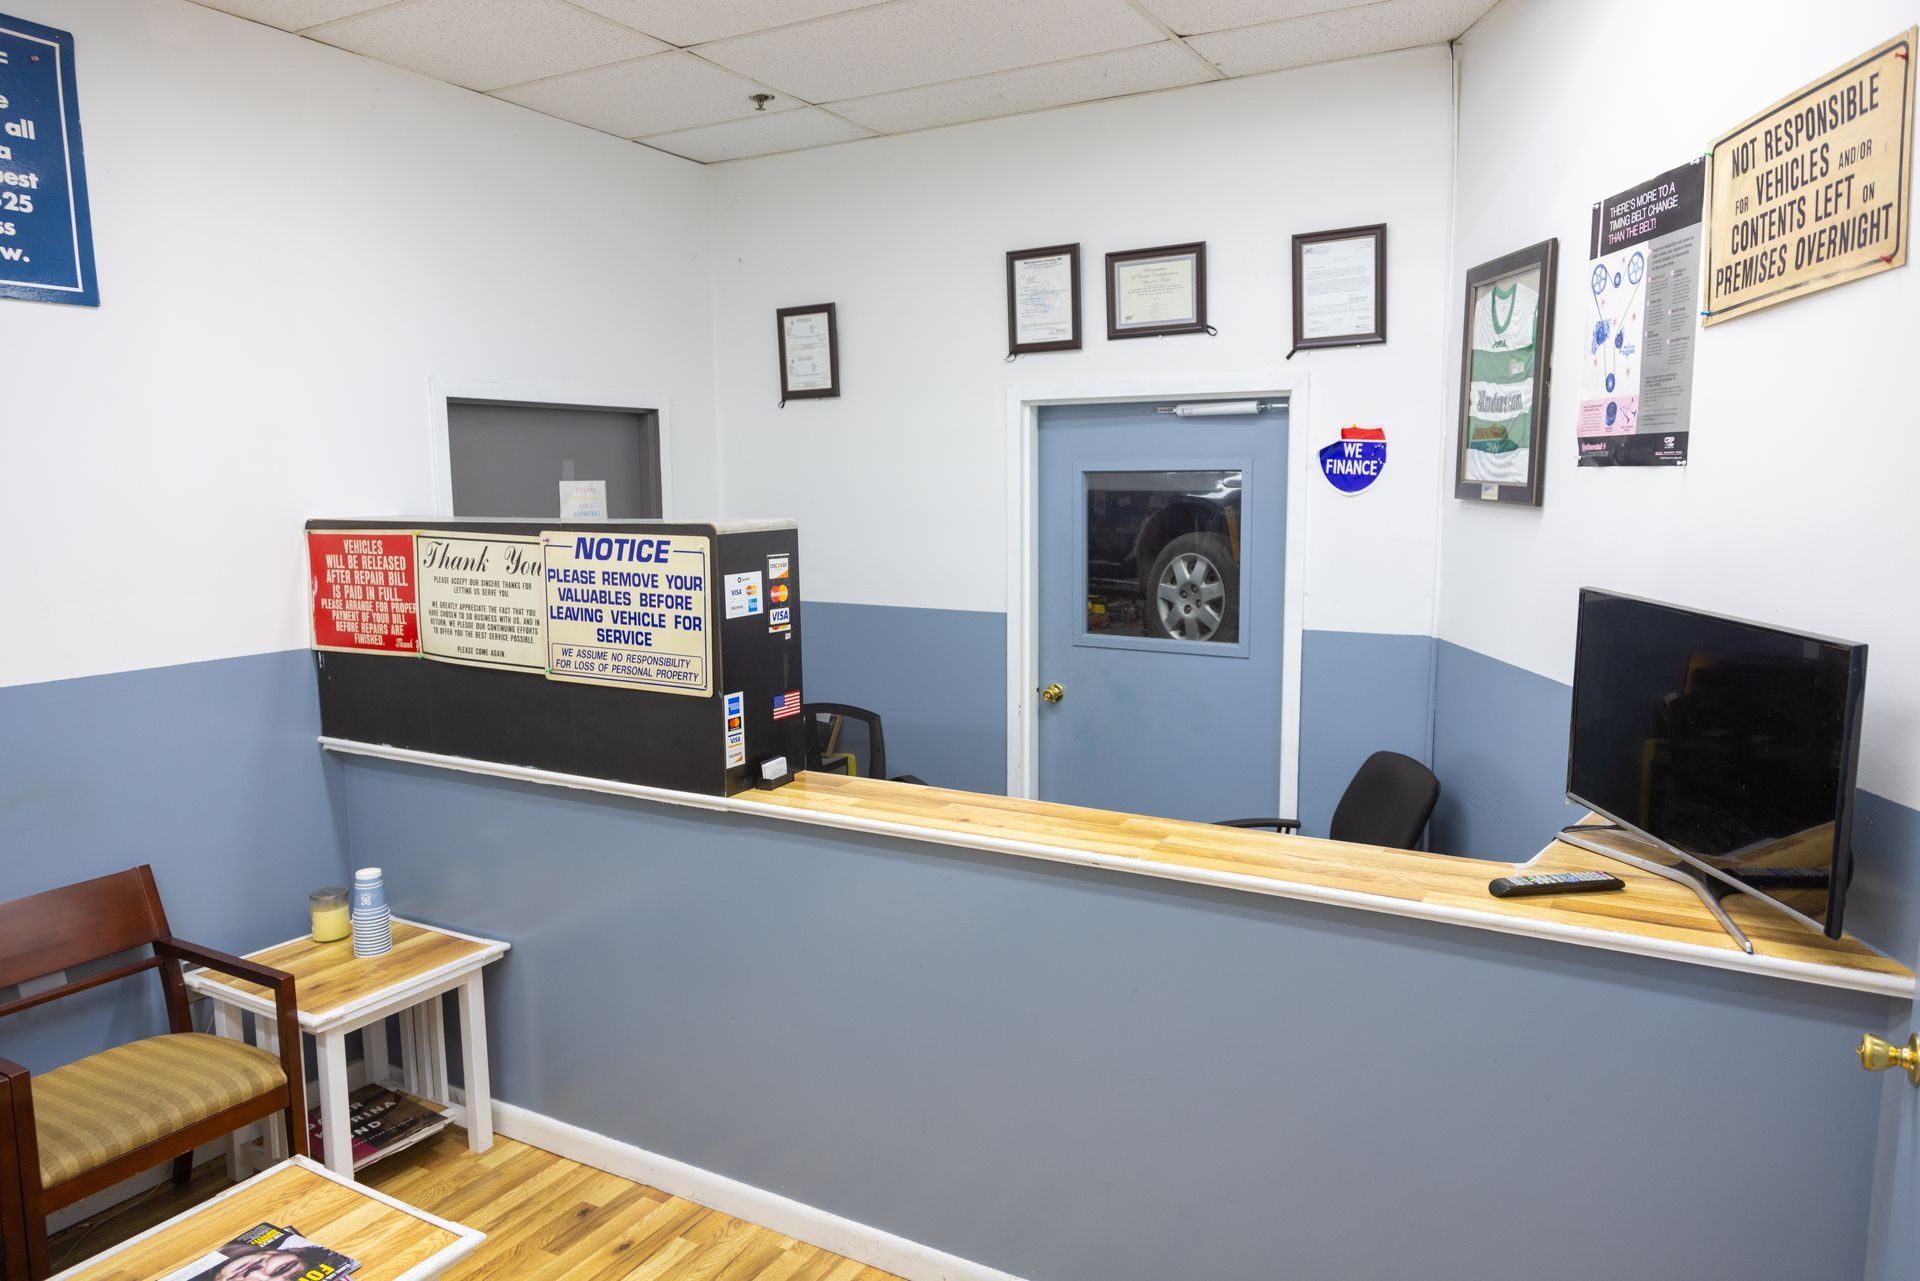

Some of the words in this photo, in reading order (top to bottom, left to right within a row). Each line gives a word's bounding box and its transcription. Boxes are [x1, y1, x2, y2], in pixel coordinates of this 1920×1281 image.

[5, 118, 35, 140] all
[1732, 136, 1757, 179] NOT
[1765, 72, 1879, 163] RESPONSIBLE
[1736, 197, 1749, 216] FOR
[1757, 142, 1829, 205] VEHICLES
[1838, 139, 1872, 170] AND/OR
[1610, 198, 1635, 218] THERE'S
[1637, 189, 1657, 206] MORE
[1659, 184, 1668, 198] TO
[1669, 182, 1675, 193] A
[1610, 215, 1630, 231] TIMING
[1631, 206, 1647, 224] BELT
[1648, 195, 1678, 216] CHANGE
[1732, 196, 1805, 255] CONTENTS
[1815, 174, 1855, 223] LEFT
[1863, 182, 1875, 203] ON
[1609, 230, 1624, 245] THAN
[1626, 225, 1638, 239] THE
[1640, 218, 1656, 234] BELT!
[1716, 244, 1787, 298] PREMISES
[1795, 203, 1893, 271] OVERNIGHT
[1344, 443, 1363, 458] WE
[1326, 459, 1378, 475] FINANCE
[344, 540, 383, 554] VEHICLES
[575, 537, 671, 563] NOTICE
[326, 554, 345, 568] WILL
[348, 556, 359, 569] BE
[362, 556, 406, 570] RELEASED
[423, 541, 488, 572] Thank
[504, 546, 541, 576] You
[327, 570, 351, 584] AFTER
[354, 571, 384, 585] REPAIR
[388, 572, 408, 586] BILL
[434, 576, 449, 584] PLEASE
[481, 580, 500, 588] SINCERE
[503, 581, 520, 589] THANKS
[523, 582, 531, 590] FOR
[548, 569, 595, 584] PLEASE
[603, 571, 658, 588] REMOVE
[666, 575, 702, 591] YOUR
[333, 585, 341, 598] IS
[344, 585, 362, 599] PAID
[366, 586, 374, 600] IN
[379, 587, 402, 601] FULL.
[558, 587, 631, 606] VALUABLES
[640, 593, 692, 610] BEFORE
[322, 599, 342, 610] PLEASE
[346, 600, 373, 611] ARRANGE
[376, 602, 388, 612] FOR
[391, 602, 416, 614] PROPER
[440, 602, 457, 610] GREATLY
[460, 603, 486, 612] APPRECIATE
[488, 605, 496, 613] THE
[332, 610, 359, 621] PAYMENT
[362, 612, 370, 622] OF
[372, 613, 389, 623] YOUR
[392, 614, 407, 624] BILL
[474, 614, 497, 622] BUSINESS
[550, 606, 603, 622] LEAVING
[611, 610, 666, 628] VEHICLE
[675, 615, 702, 631] FOR
[772, 611, 788, 621] VISA
[336, 622, 359, 632] BEFORE
[362, 623, 388, 635] REPAIRS
[391, 625, 404, 636] ARE
[458, 621, 473, 629] PLEDGE
[488, 624, 515, 633] CONTINUING
[517, 626, 538, 635] EFFORTS
[355, 634, 385, 646] FINISHED.
[396, 638, 413, 648] Thank
[489, 633, 508, 641] SERVICE
[597, 628, 652, 646] SERVICE
[457, 646, 473, 654] PLEASE
[476, 648, 488, 656] COME
[562, 648, 573, 657] WE
[576, 649, 607, 660] ASSUME
[612, 653, 623, 661] NO
[626, 654, 691, 668] RESPONSIBILITY
[556, 659, 570, 668] FOR
[574, 661, 594, 671] LOSS
[598, 664, 608, 672] OF
[612, 665, 652, 677] PERSONAL
[656, 671, 699, 681] PROPERTY
[730, 736, 741, 744] VISA
